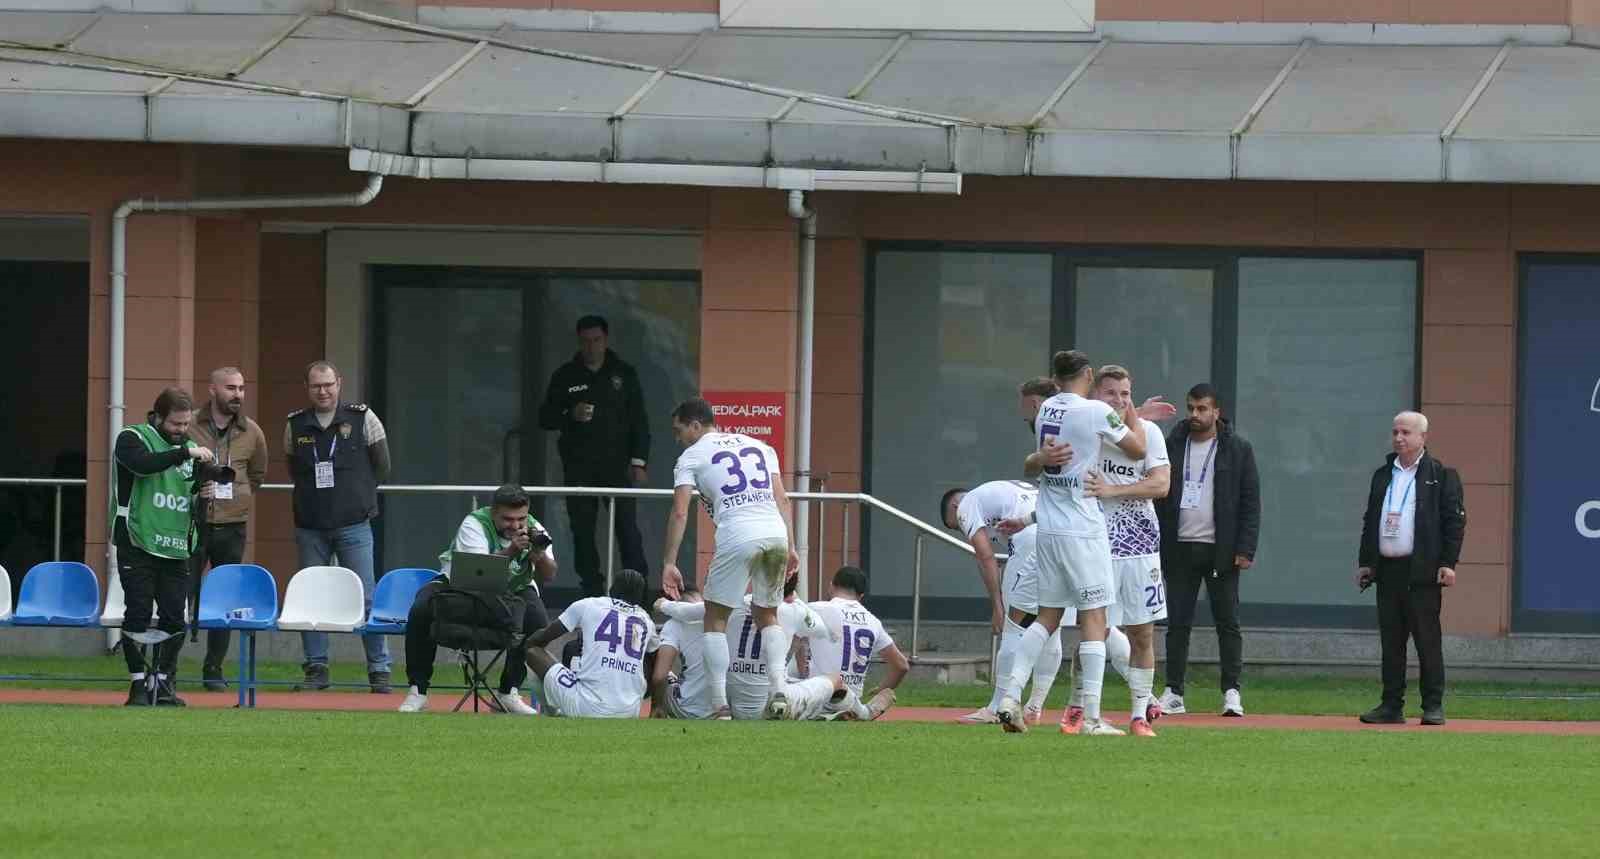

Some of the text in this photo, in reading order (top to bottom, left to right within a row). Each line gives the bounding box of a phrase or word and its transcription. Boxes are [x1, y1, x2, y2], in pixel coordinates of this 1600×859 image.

[1043, 407, 1067, 420] YKT
[711, 447, 770, 495] 33
[1103, 459, 1134, 477] ikas
[1144, 584, 1164, 607] 20
[594, 609, 648, 661] 40
[738, 614, 762, 660] 11
[840, 625, 876, 674] 19
